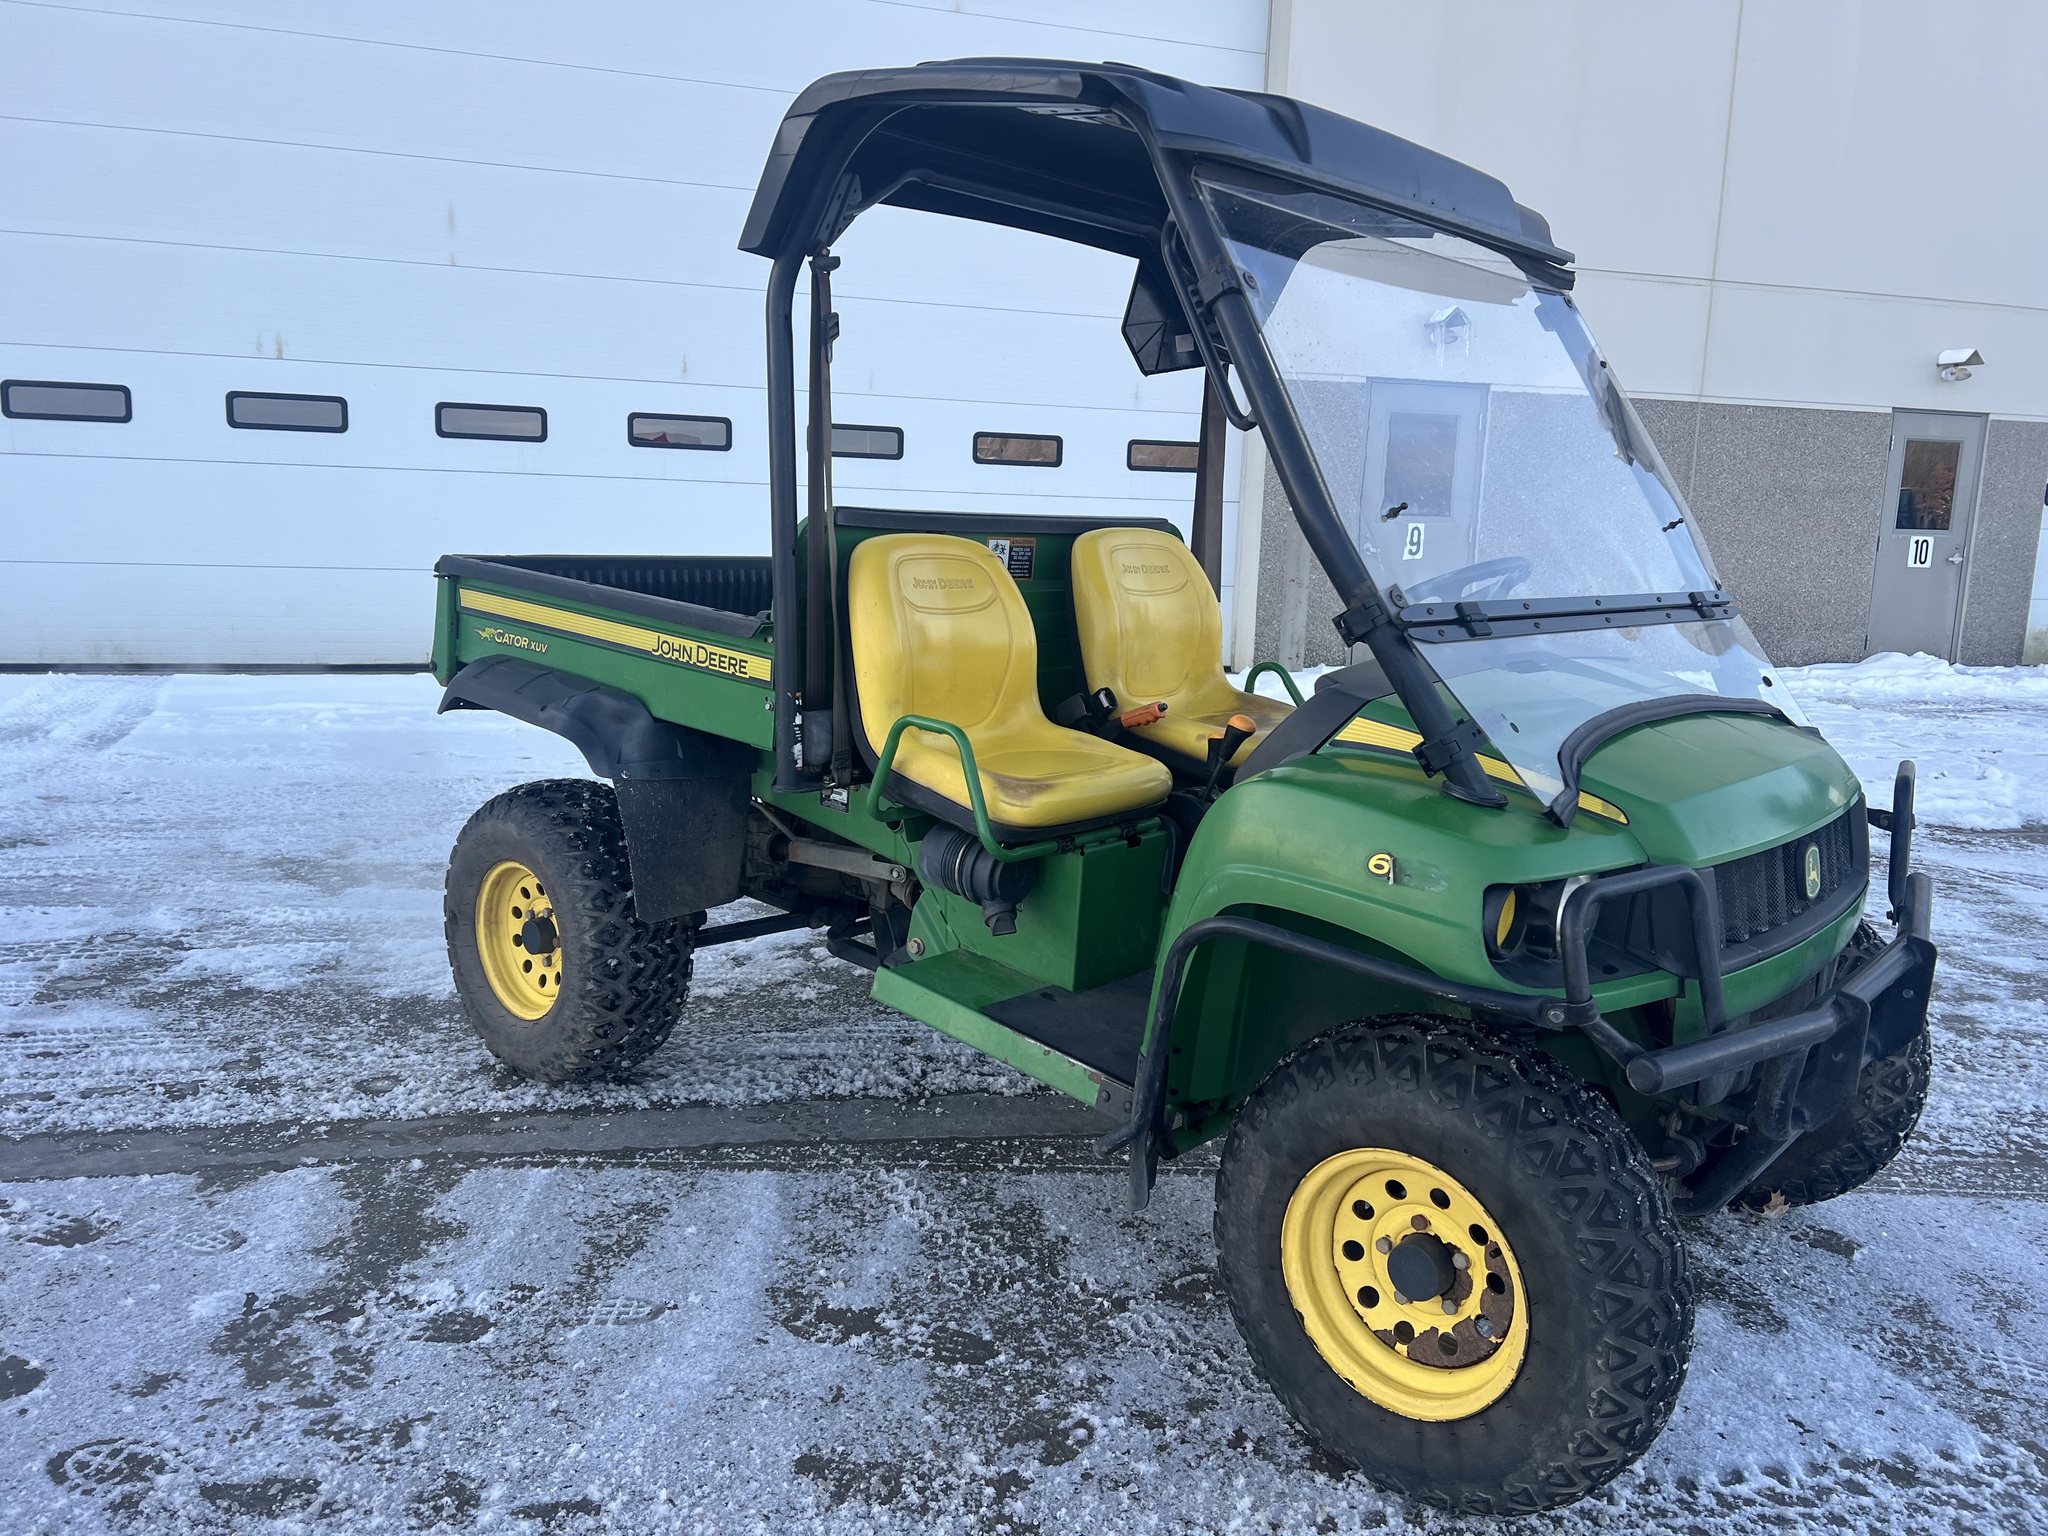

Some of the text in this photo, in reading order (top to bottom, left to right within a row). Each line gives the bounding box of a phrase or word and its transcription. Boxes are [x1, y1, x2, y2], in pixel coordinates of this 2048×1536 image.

[1408, 526, 1421, 556] 9
[1913, 539, 1929, 565] 10
[912, 576, 974, 590] JOHN DEERE
[494, 629, 548, 653] GATOR XUV
[652, 635, 749, 676] JOHN DEERE
